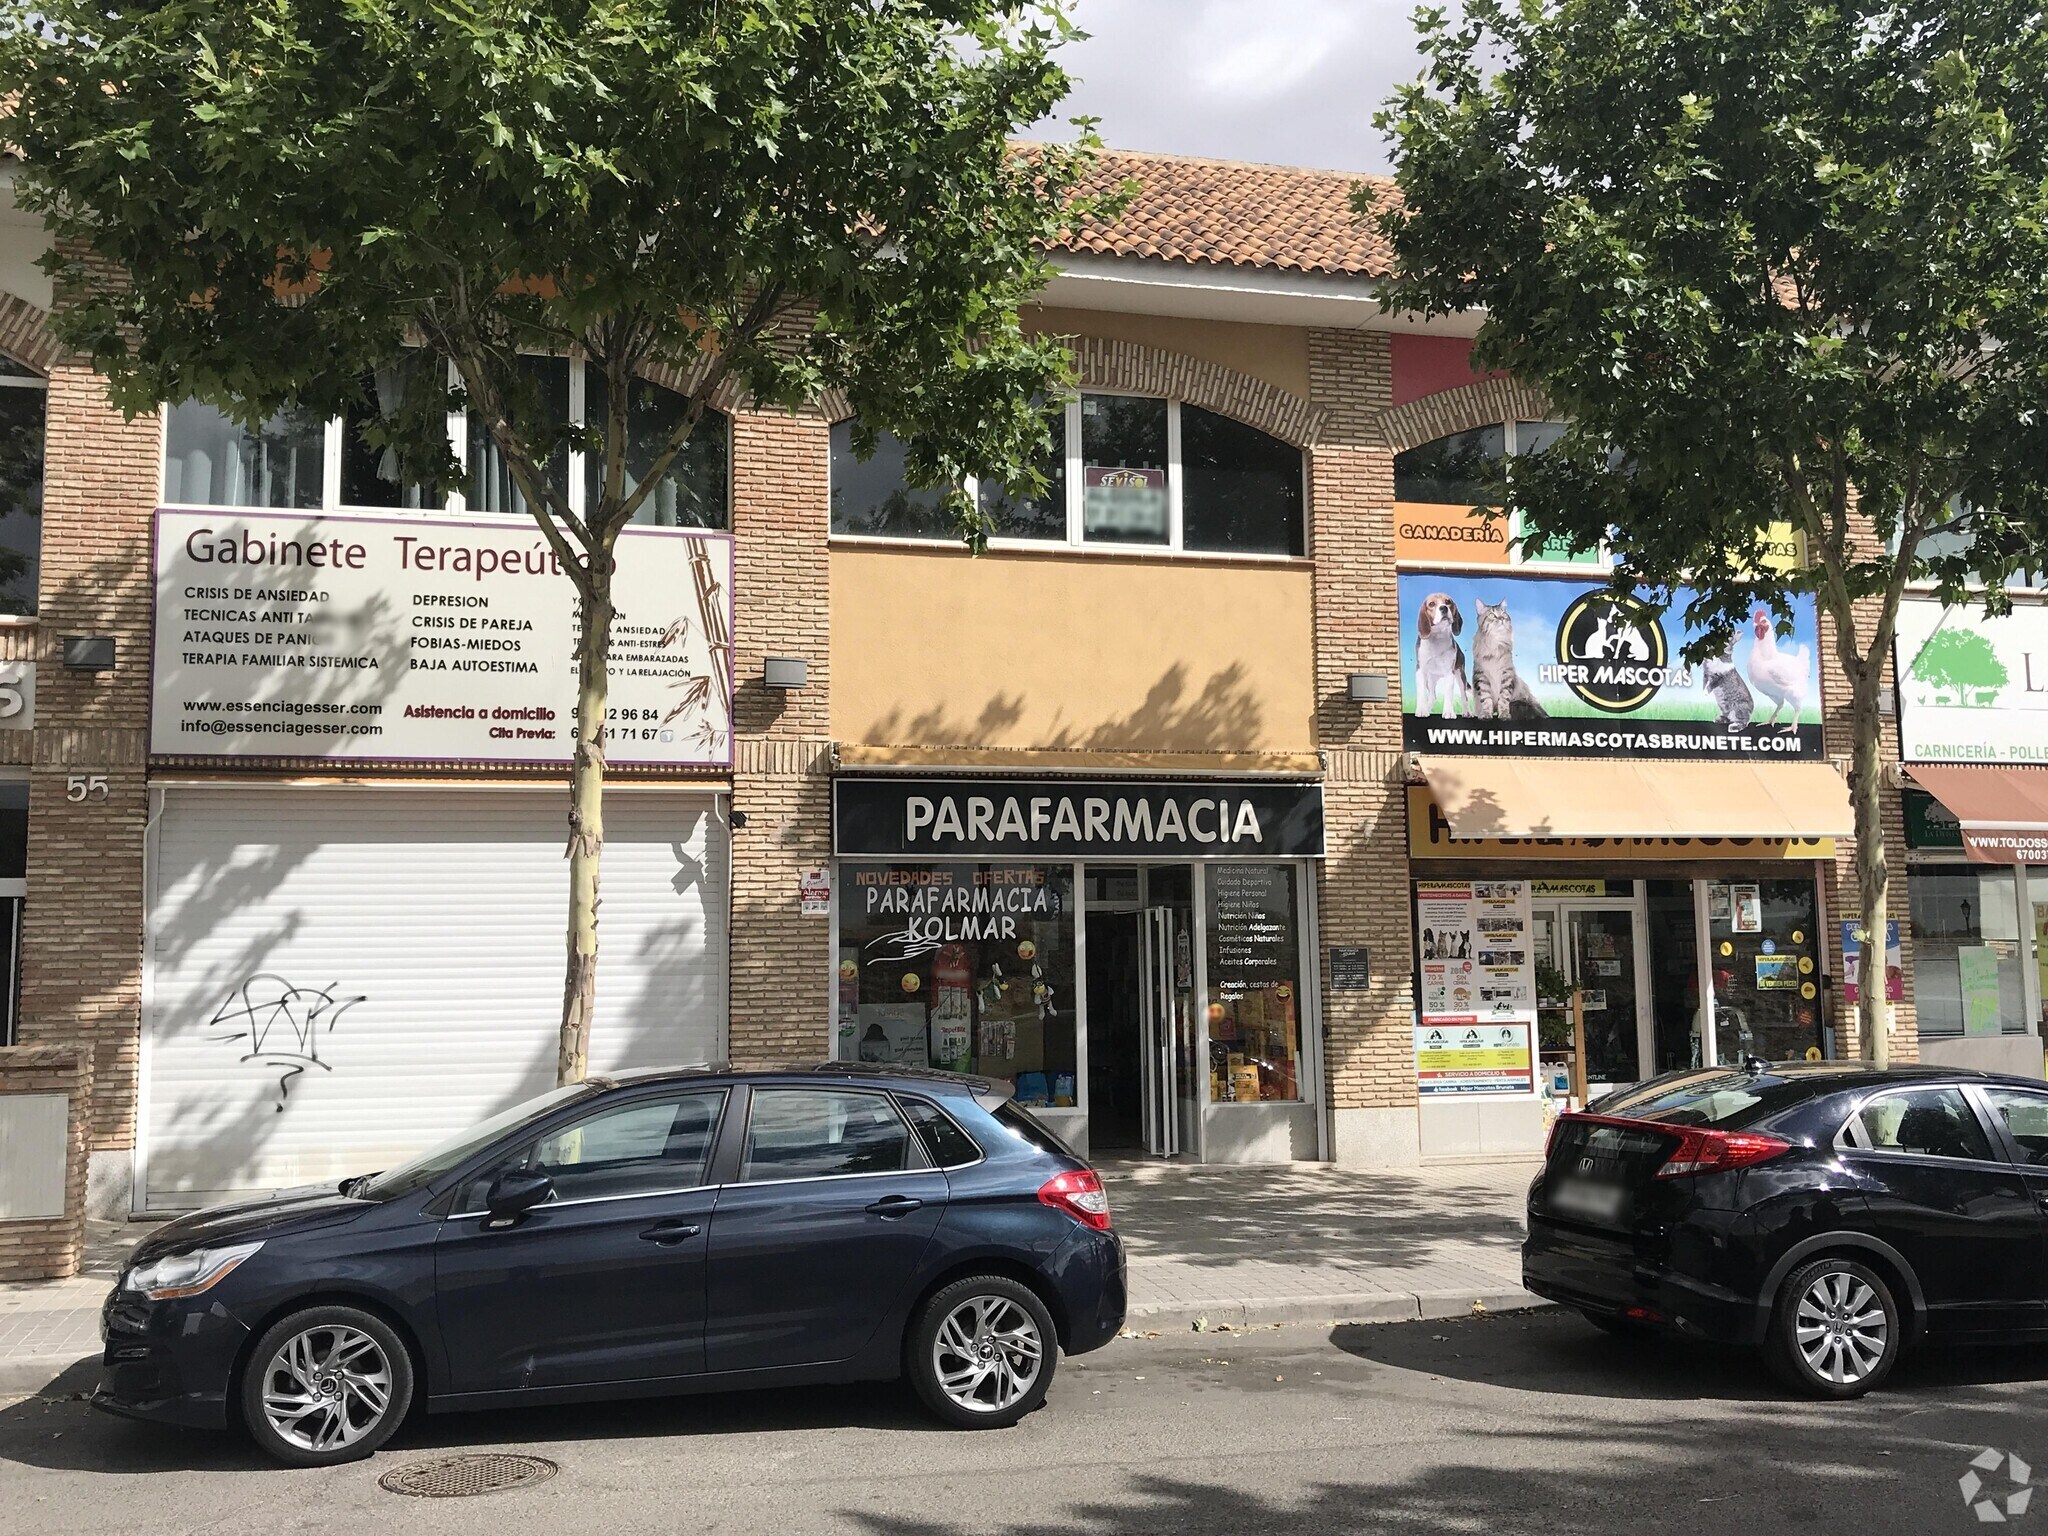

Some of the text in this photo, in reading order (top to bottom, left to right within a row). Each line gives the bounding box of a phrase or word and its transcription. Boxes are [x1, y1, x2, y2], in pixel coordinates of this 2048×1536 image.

[1399, 523, 1504, 543] GANADERÍA
[186, 528, 616, 581] Gabinete Terapeút
[184, 587, 329, 602] CRISIS DE ANSIEDAD
[413, 594, 489, 608] DEPRESION
[184, 609, 257, 623] TECNICAS
[261, 611, 293, 624] ANTI
[412, 616, 533, 631] CRISIS DE PAREJA
[616, 626, 666, 635] ANSIEDAD
[183, 631, 250, 645] ATAQUES
[255, 633, 272, 645] DE
[411, 637, 521, 651] FOBIAS-MIEDOS
[618, 640, 666, 648] ANTI-ESTRES
[182, 653, 379, 669] TERAPIA FAMILIAR SISTEMICA
[626, 654, 689, 663] EMBARAZADAS
[410, 659, 539, 673] BAJA AUTOESTIMA
[639, 668, 691, 677] RELAJACIÓN
[1539, 663, 1692, 688] HIPER MASCOTAS
[183, 701, 383, 716] www.essenciagesser.com
[404, 704, 475, 720] Asistencia
[479, 709, 488, 719] a
[492, 706, 555, 721] domicilio
[622, 709, 638, 720] 96
[642, 709, 658, 720] 84
[181, 720, 383, 736] info@essenciagesser.com
[489, 727, 513, 739] Cita
[516, 728, 556, 740] Previa:
[621, 728, 636, 739] 71
[642, 729, 658, 740] 67
[1427, 728, 1802, 752] WWW.HIPERMASCOTASBRUNETE.COM
[1915, 741, 1997, 759] CARNICERÍA
[66, 775, 109, 802] 55
[906, 796, 1263, 842] PARAFARMACIA
[2016, 850, 2048, 860] 67003
[856, 868, 1045, 886] NOVEDADES OFERTAS
[1242, 878, 1272, 887] Deportivo
[1218, 889, 1267, 899] Higiene Personal
[1550, 885, 1596, 893] MASCOTAS
[866, 886, 1048, 913] PARAFARMACIA
[1218, 901, 1241, 910] Higiene
[908, 915, 1017, 940] KOLMAR
[1218, 923, 1286, 933] Nutrición Adelgazante
[1219, 946, 1251, 954] Infusiones
[1244, 957, 1277, 967] Corporales
[1220, 992, 1244, 1002] Regalos
